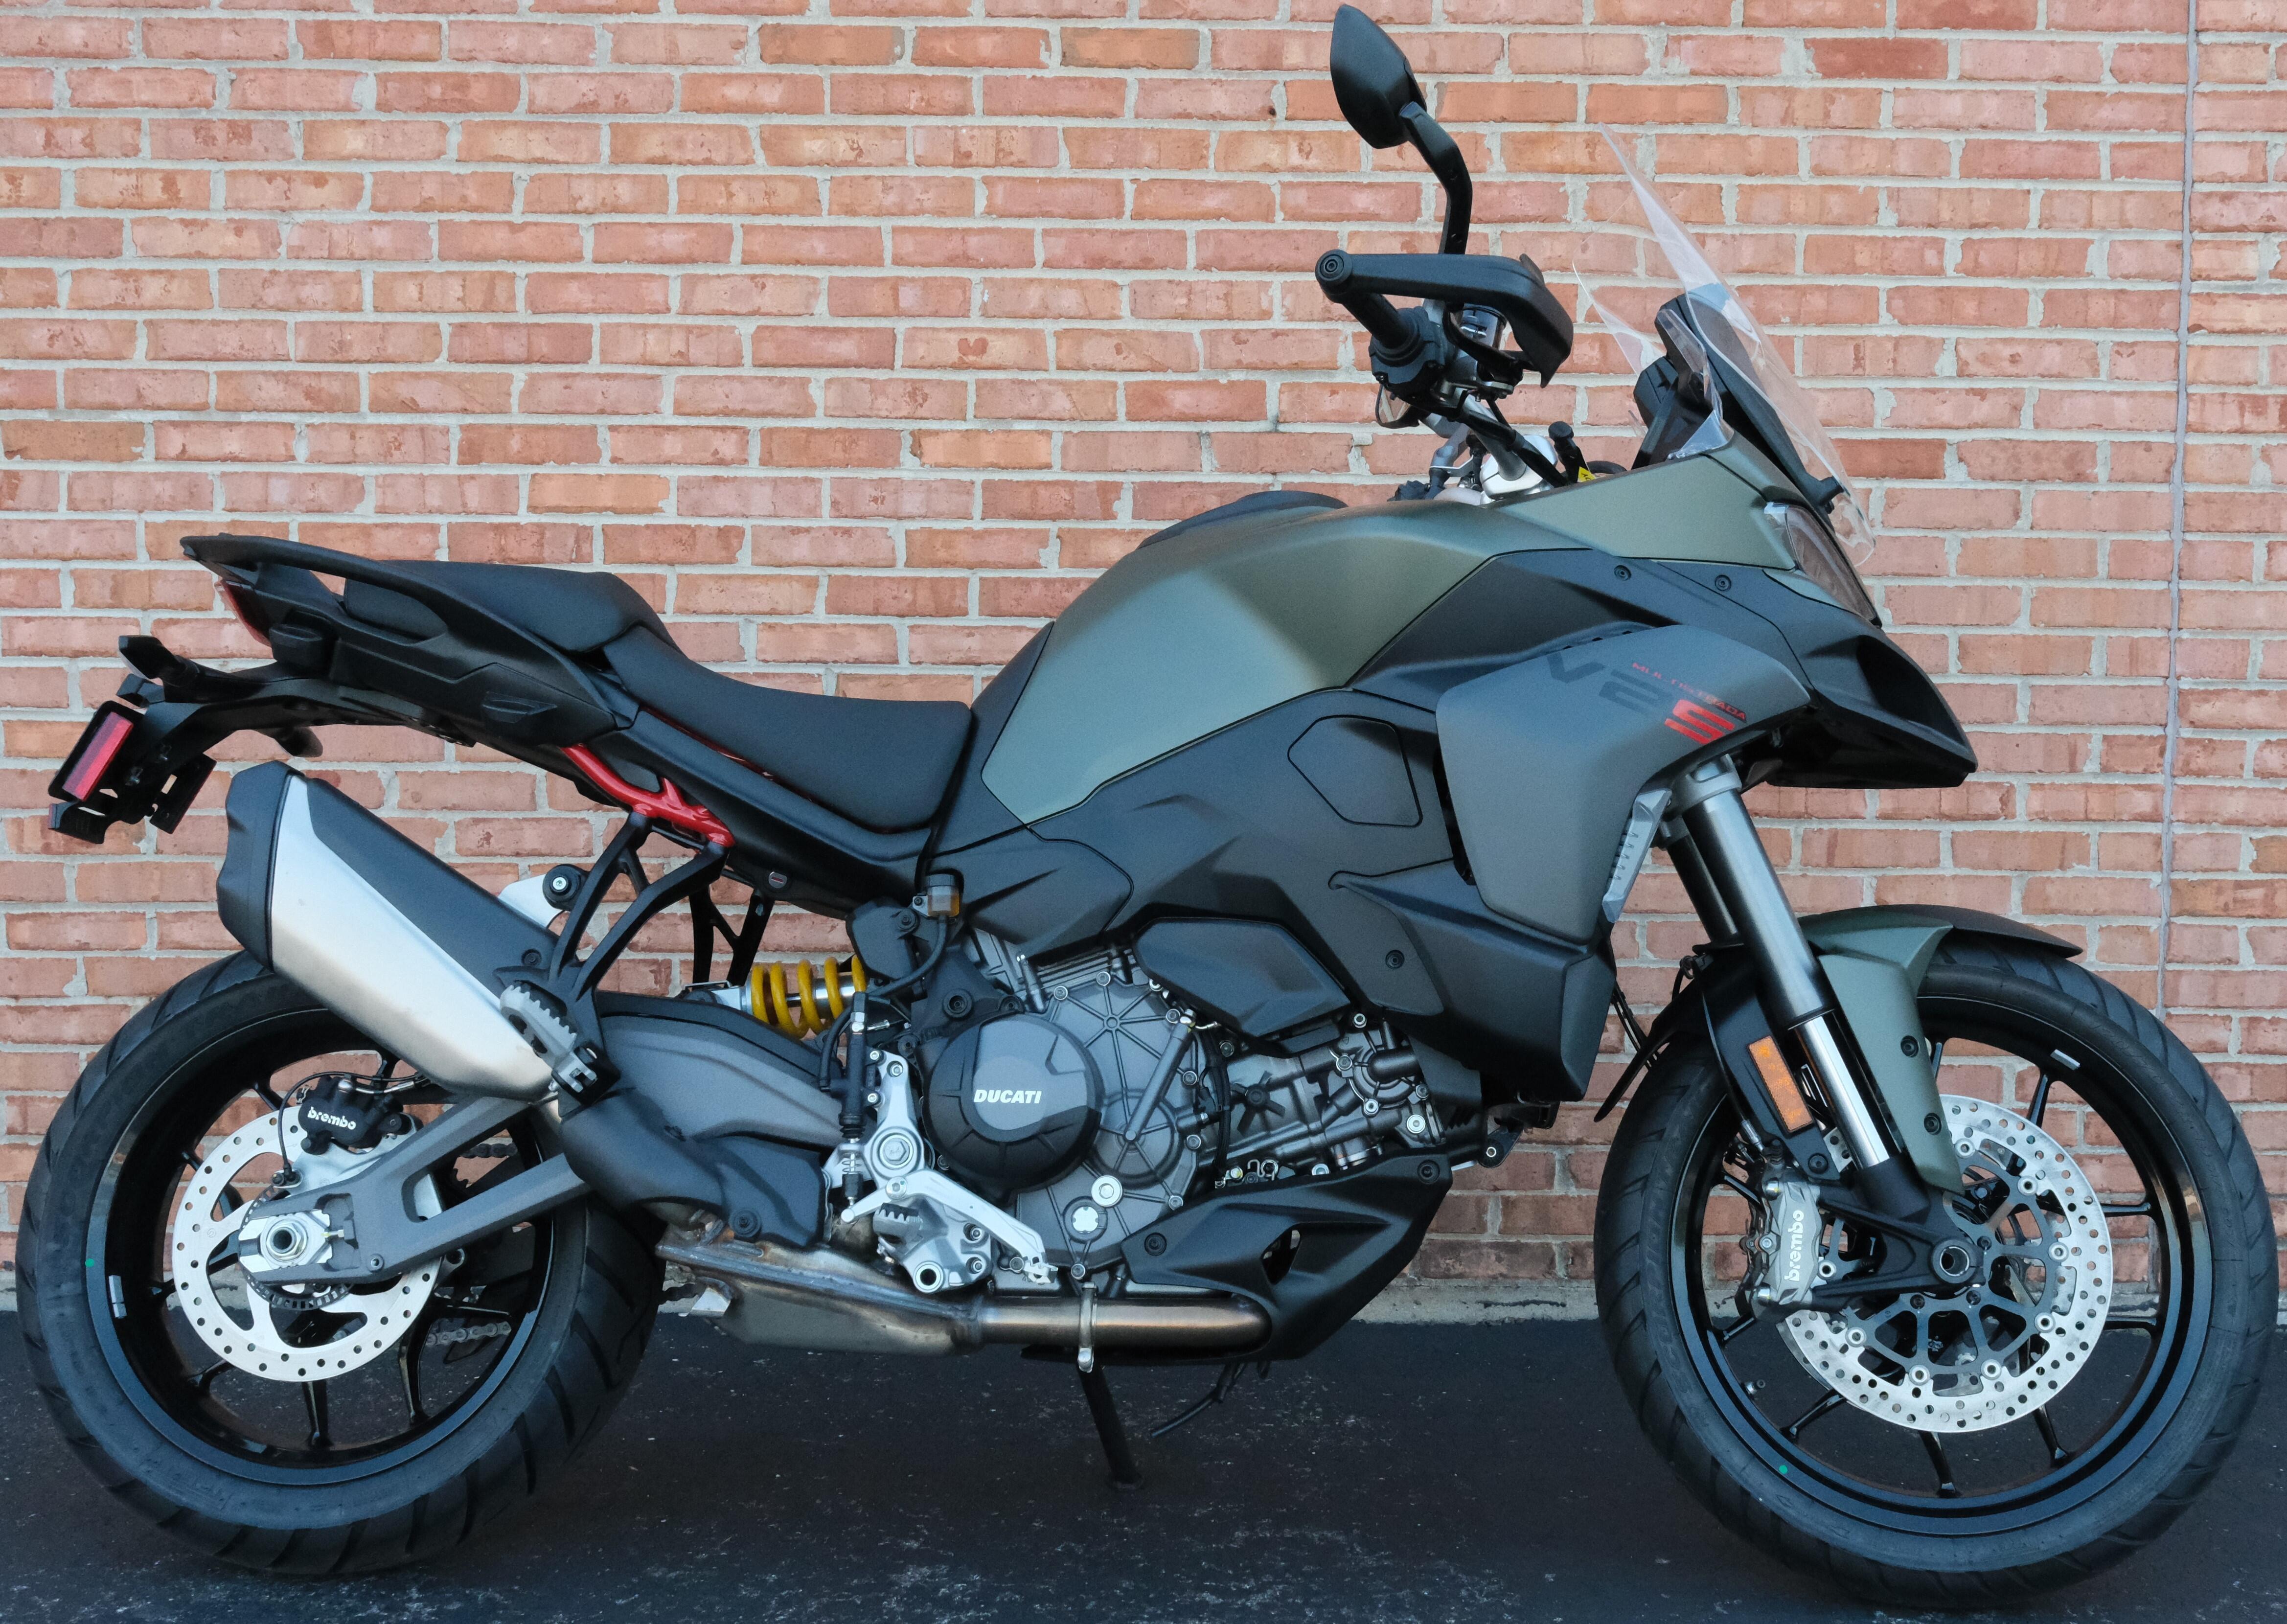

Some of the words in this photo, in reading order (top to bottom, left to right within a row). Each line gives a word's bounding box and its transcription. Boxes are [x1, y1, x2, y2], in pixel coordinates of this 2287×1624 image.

[974, 1089, 1042, 1104] DUCATI
[307, 1106, 356, 1130] brembo
[1784, 1210, 1804, 1281] brembo
